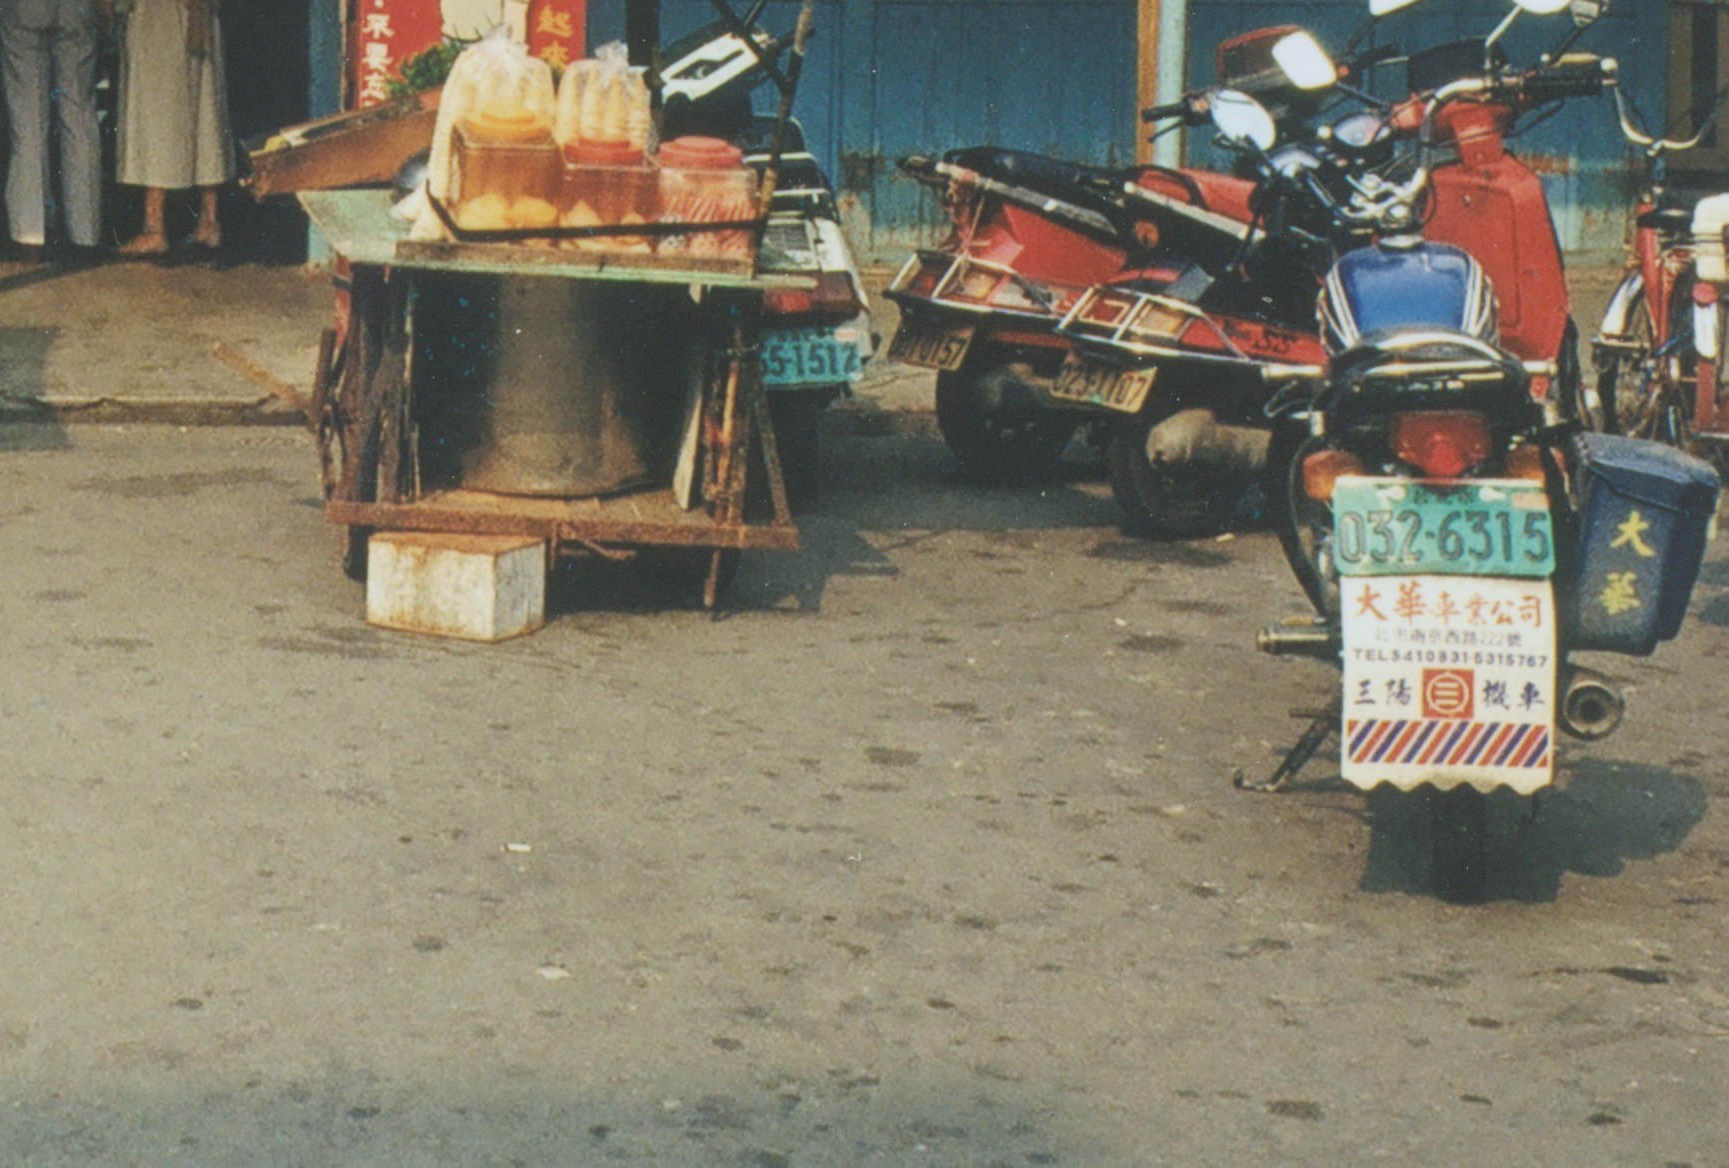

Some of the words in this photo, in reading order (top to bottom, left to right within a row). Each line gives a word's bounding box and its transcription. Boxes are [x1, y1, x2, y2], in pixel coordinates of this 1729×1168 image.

[1338, 508, 1549, 564] 032-6315
[1597, 509, 1657, 616] 大華
[1355, 579, 1543, 629] 大華車業公司
[1354, 677, 1412, 707] 三陽
[1482, 677, 1546, 711] 機車
